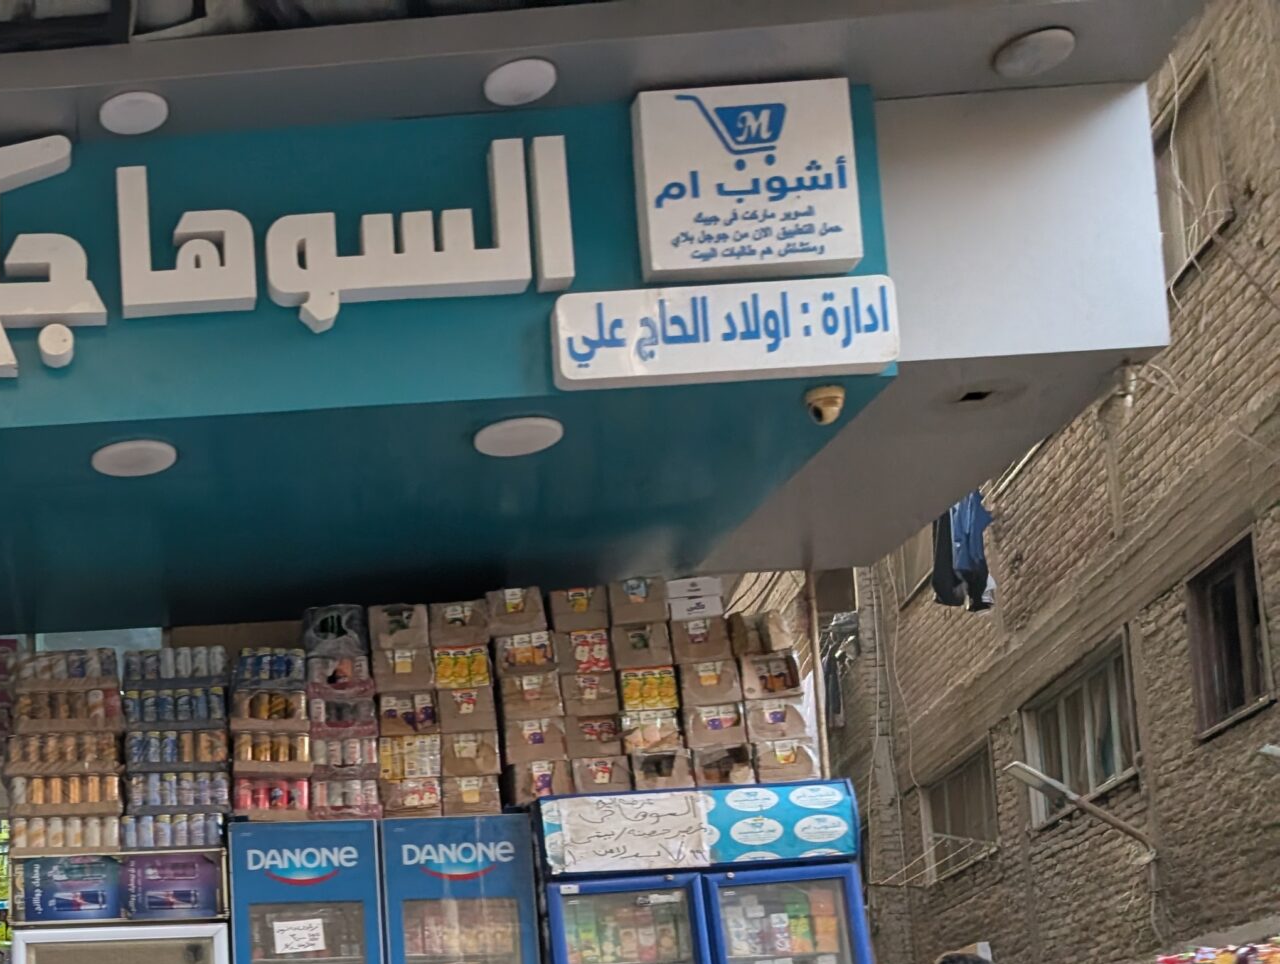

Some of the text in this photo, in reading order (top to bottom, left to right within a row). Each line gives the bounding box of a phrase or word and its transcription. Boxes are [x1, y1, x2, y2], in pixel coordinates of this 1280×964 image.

[735, 108, 773, 143] M
[654, 154, 848, 209] أشوب ام
[566, 301, 628, 369] علي
[634, 294, 711, 363] الحاج
[720, 290, 791, 353] اولاد
[821, 284, 891, 349] ادارة
